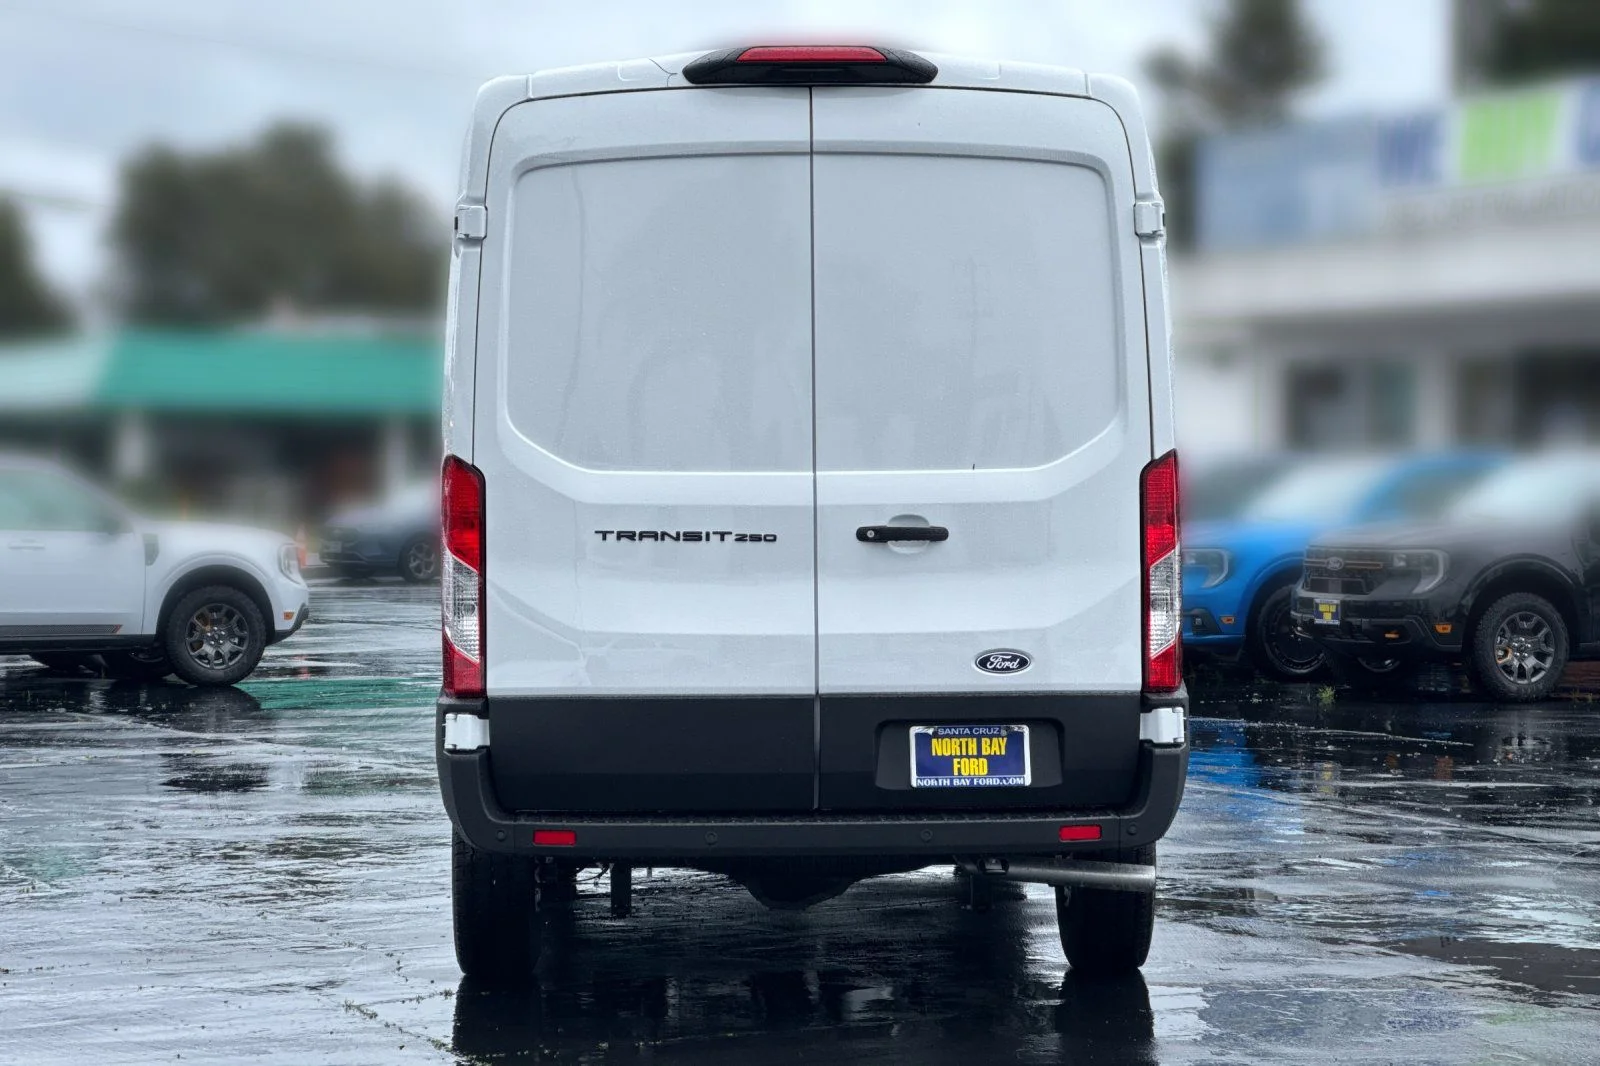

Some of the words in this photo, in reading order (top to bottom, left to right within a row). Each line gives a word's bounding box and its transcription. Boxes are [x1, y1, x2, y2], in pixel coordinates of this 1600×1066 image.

[594, 530, 732, 542] TRANSIT
[734, 533, 777, 543] 250
[986, 654, 1020, 669] Ford
[938, 727, 970, 735] SANTA
[973, 727, 1000, 735] CRUZ
[931, 738, 977, 756] NORTH
[981, 737, 1007, 755] BAY
[953, 758, 988, 776] FORD
[917, 779, 950, 787] NORTH
[954, 778, 971, 786] BAY
